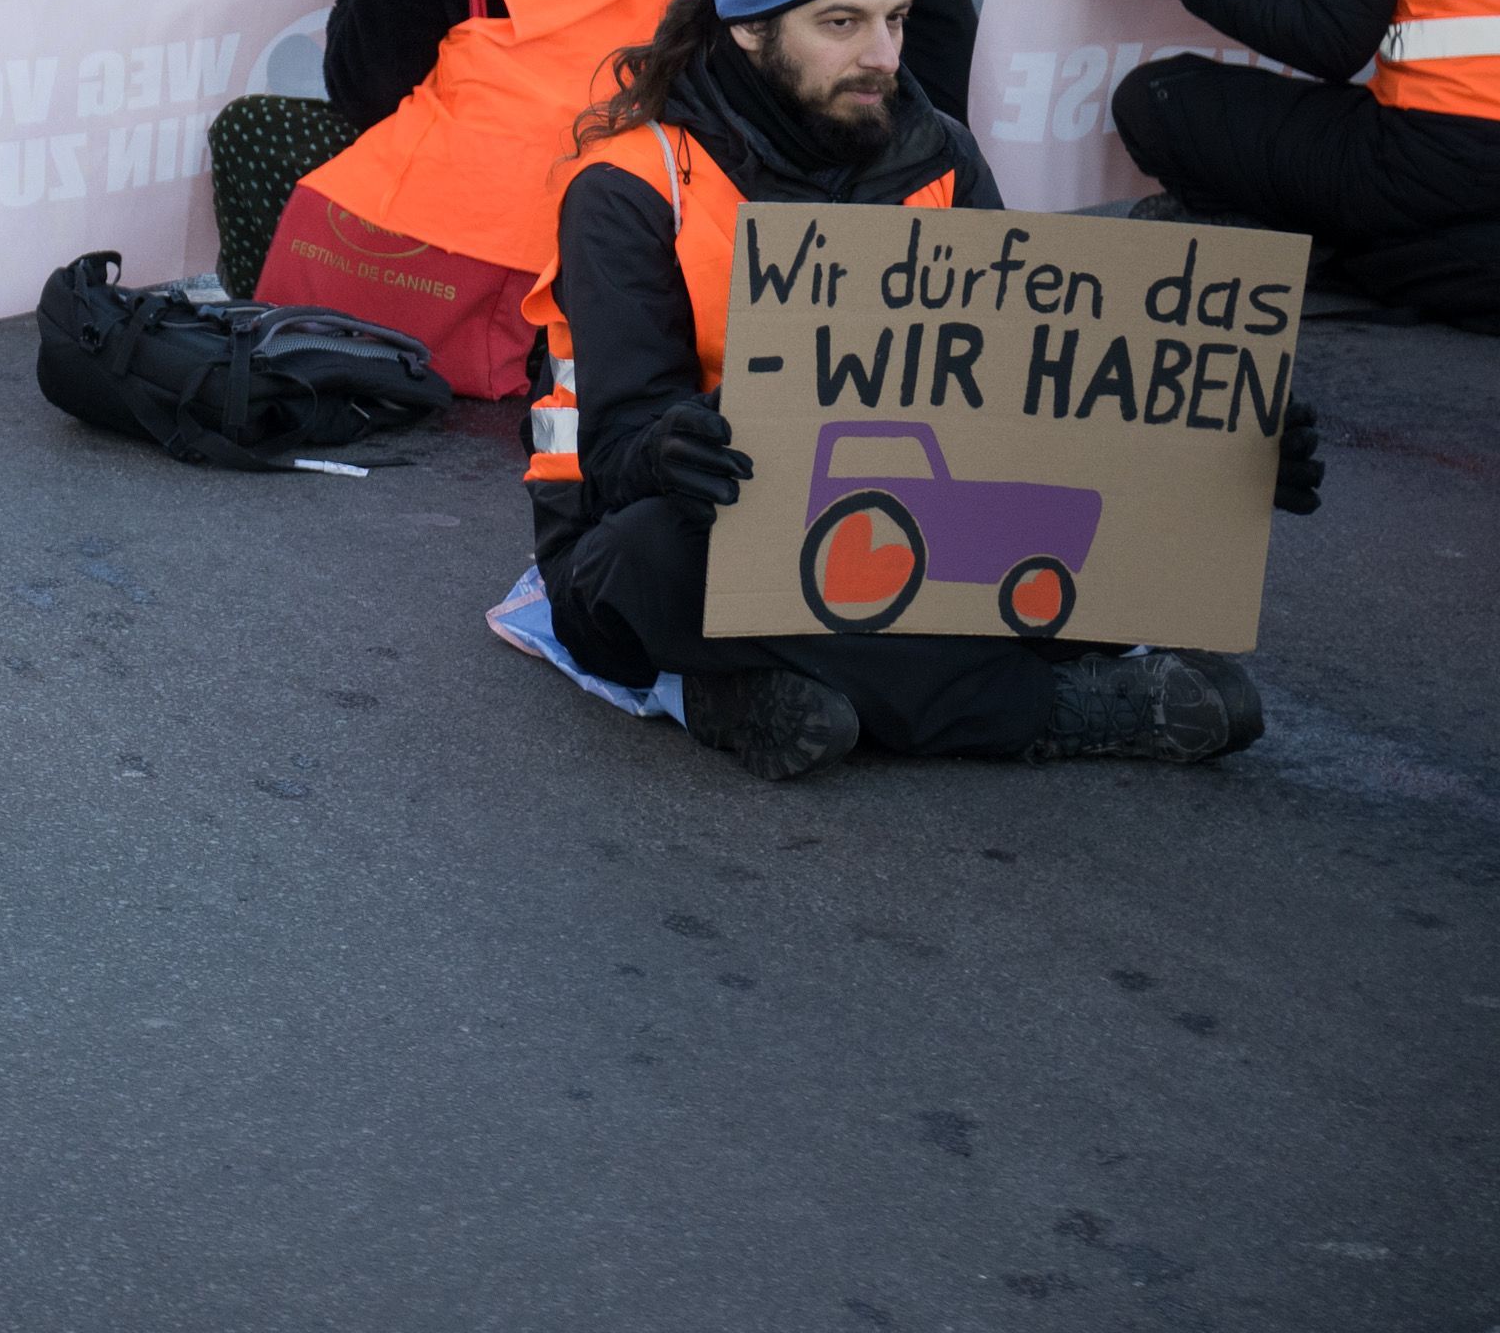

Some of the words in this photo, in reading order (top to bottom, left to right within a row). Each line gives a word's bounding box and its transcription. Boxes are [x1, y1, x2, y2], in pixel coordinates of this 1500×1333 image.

[290, 238, 354, 275] FESTIVAL
[357, 261, 380, 281] DE
[382, 268, 458, 302] CANNES
[745, 217, 847, 309] Wir
[880, 217, 1102, 320] dürfen
[1144, 239, 1292, 335] das
[1023, 325, 1292, 440] HABEN
